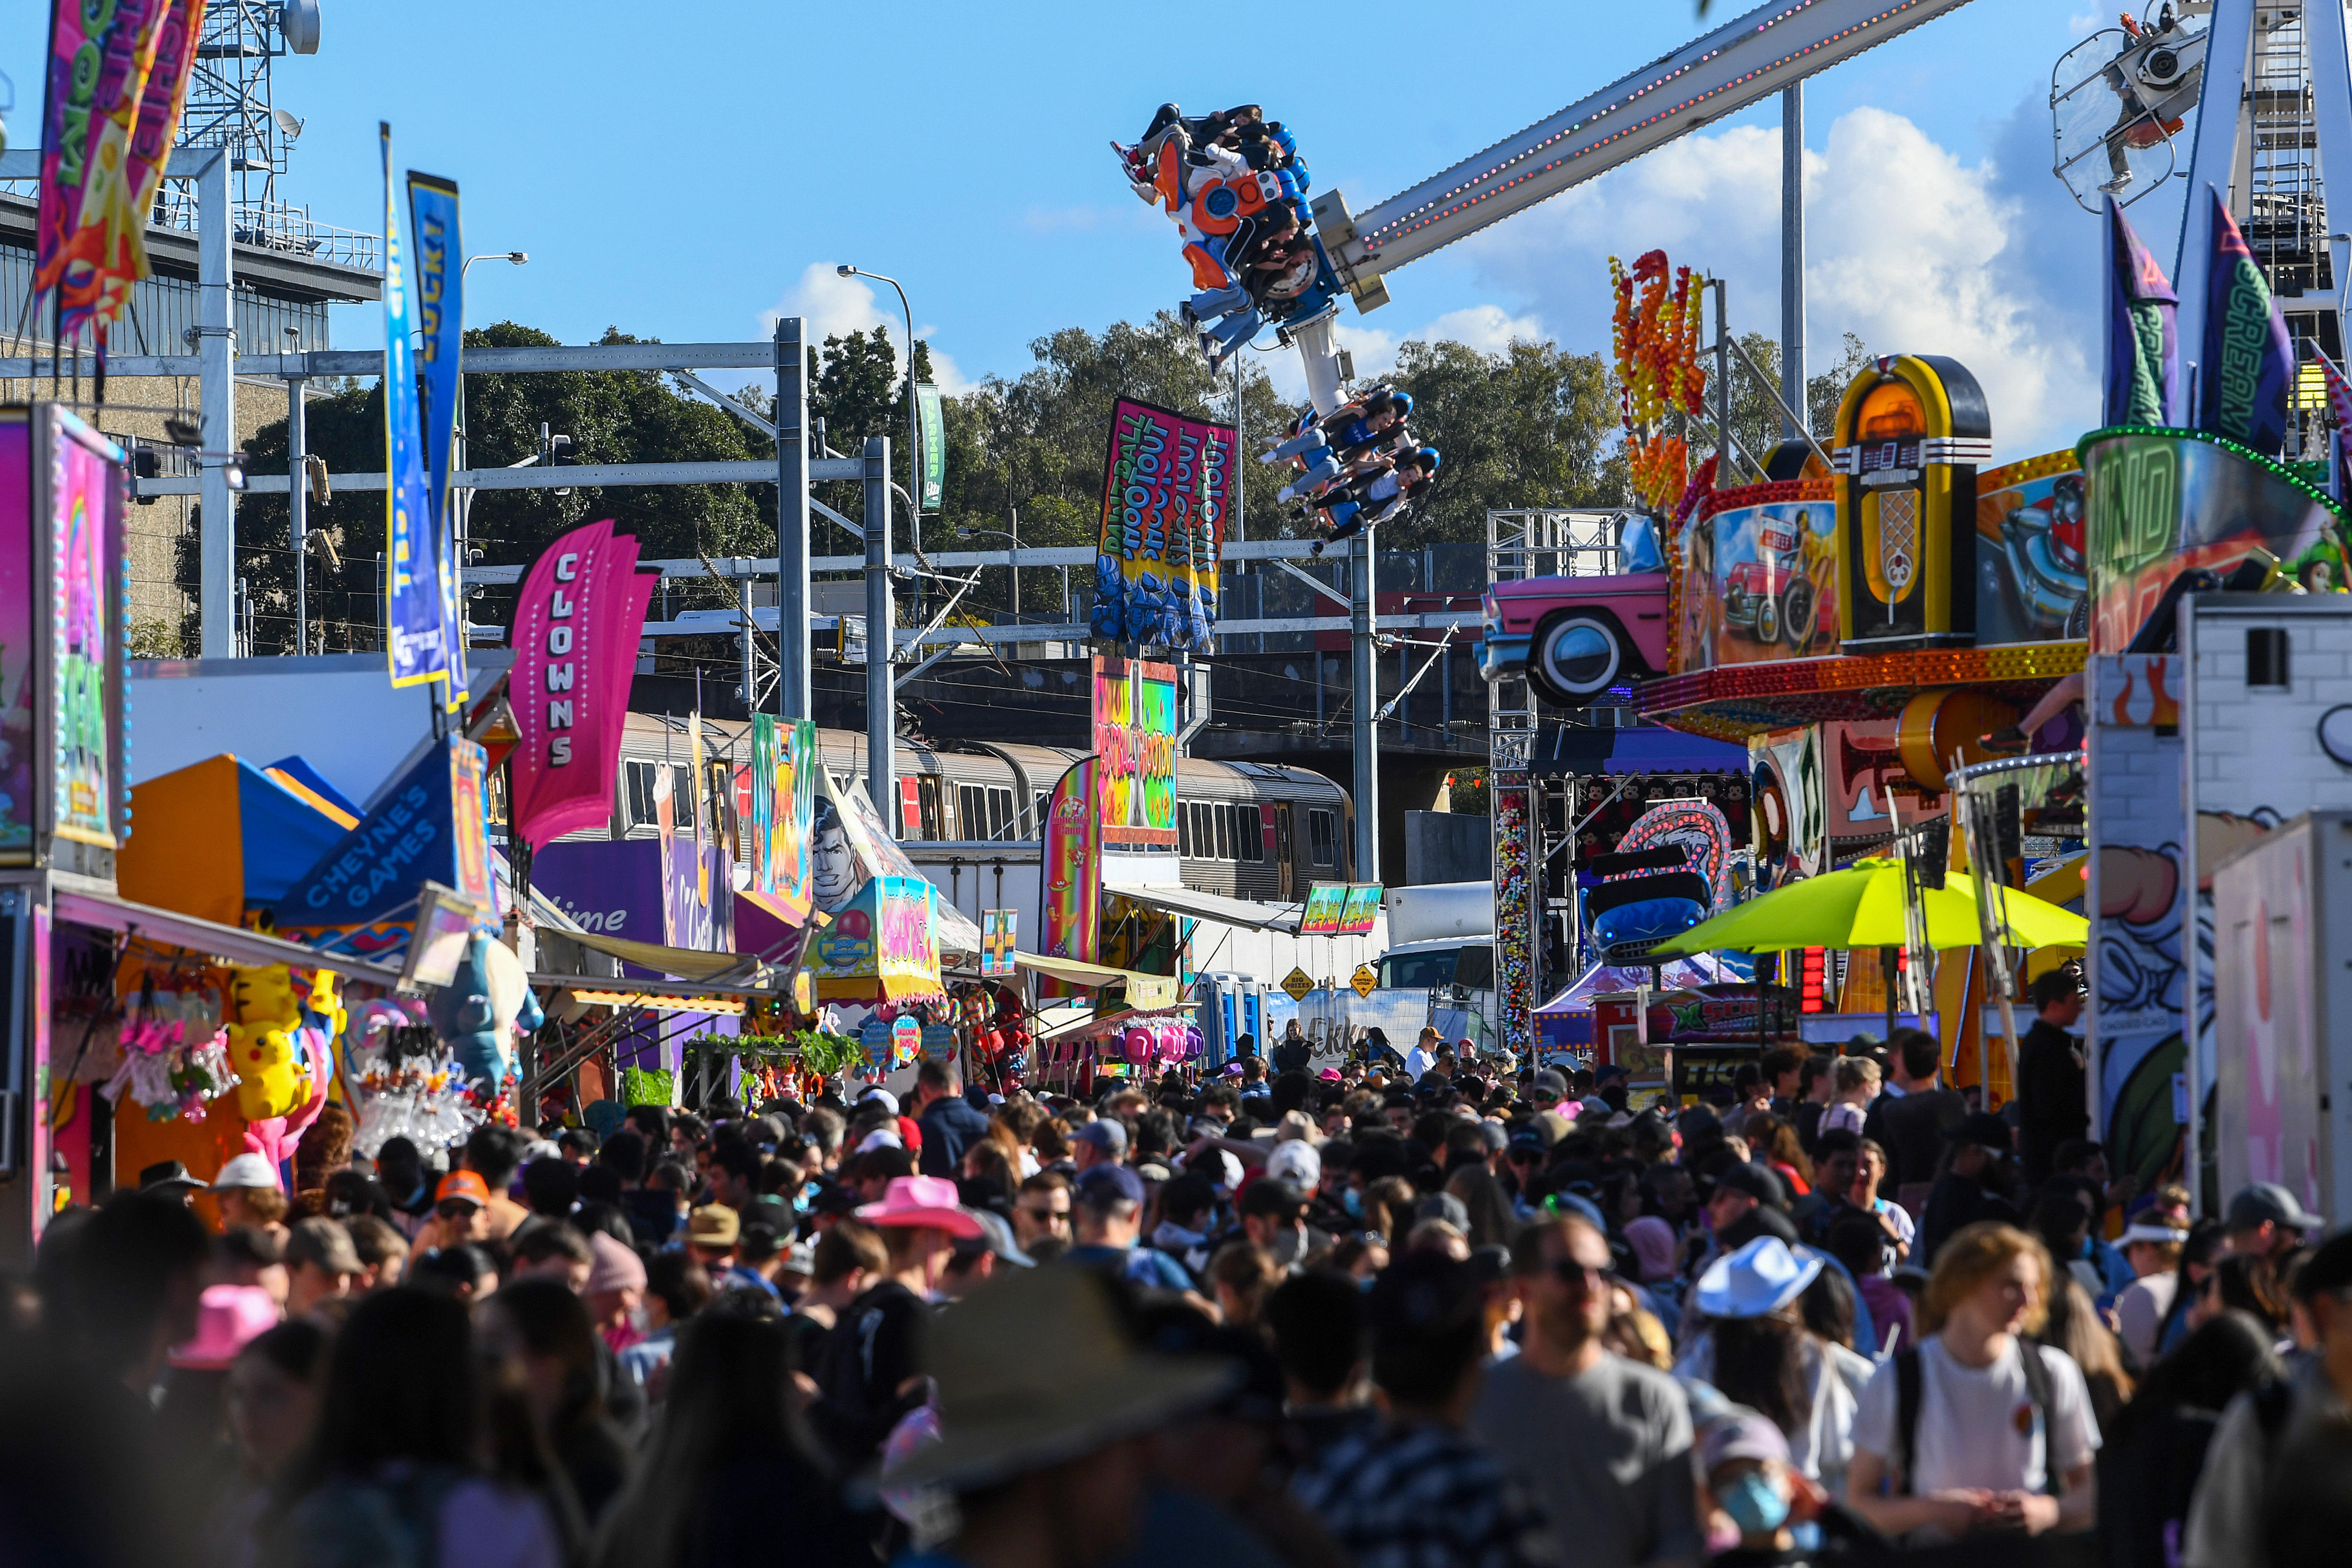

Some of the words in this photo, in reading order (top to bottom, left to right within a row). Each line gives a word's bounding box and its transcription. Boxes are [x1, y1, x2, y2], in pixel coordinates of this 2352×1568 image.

[925, 399, 939, 478] FARMER
[1104, 412, 1146, 554] PAINTBALL
[1123, 417, 1169, 560] SHOOTOUT
[1169, 427, 1199, 567] SHOOTOUT
[1194, 433, 1229, 573] SHOOTOUT
[546, 552, 578, 768] CLOWNS
[1138, 728, 1175, 781] SHOOTOUT
[307, 784, 429, 909] CHEYNE'S
[347, 819, 437, 907] GAMES
